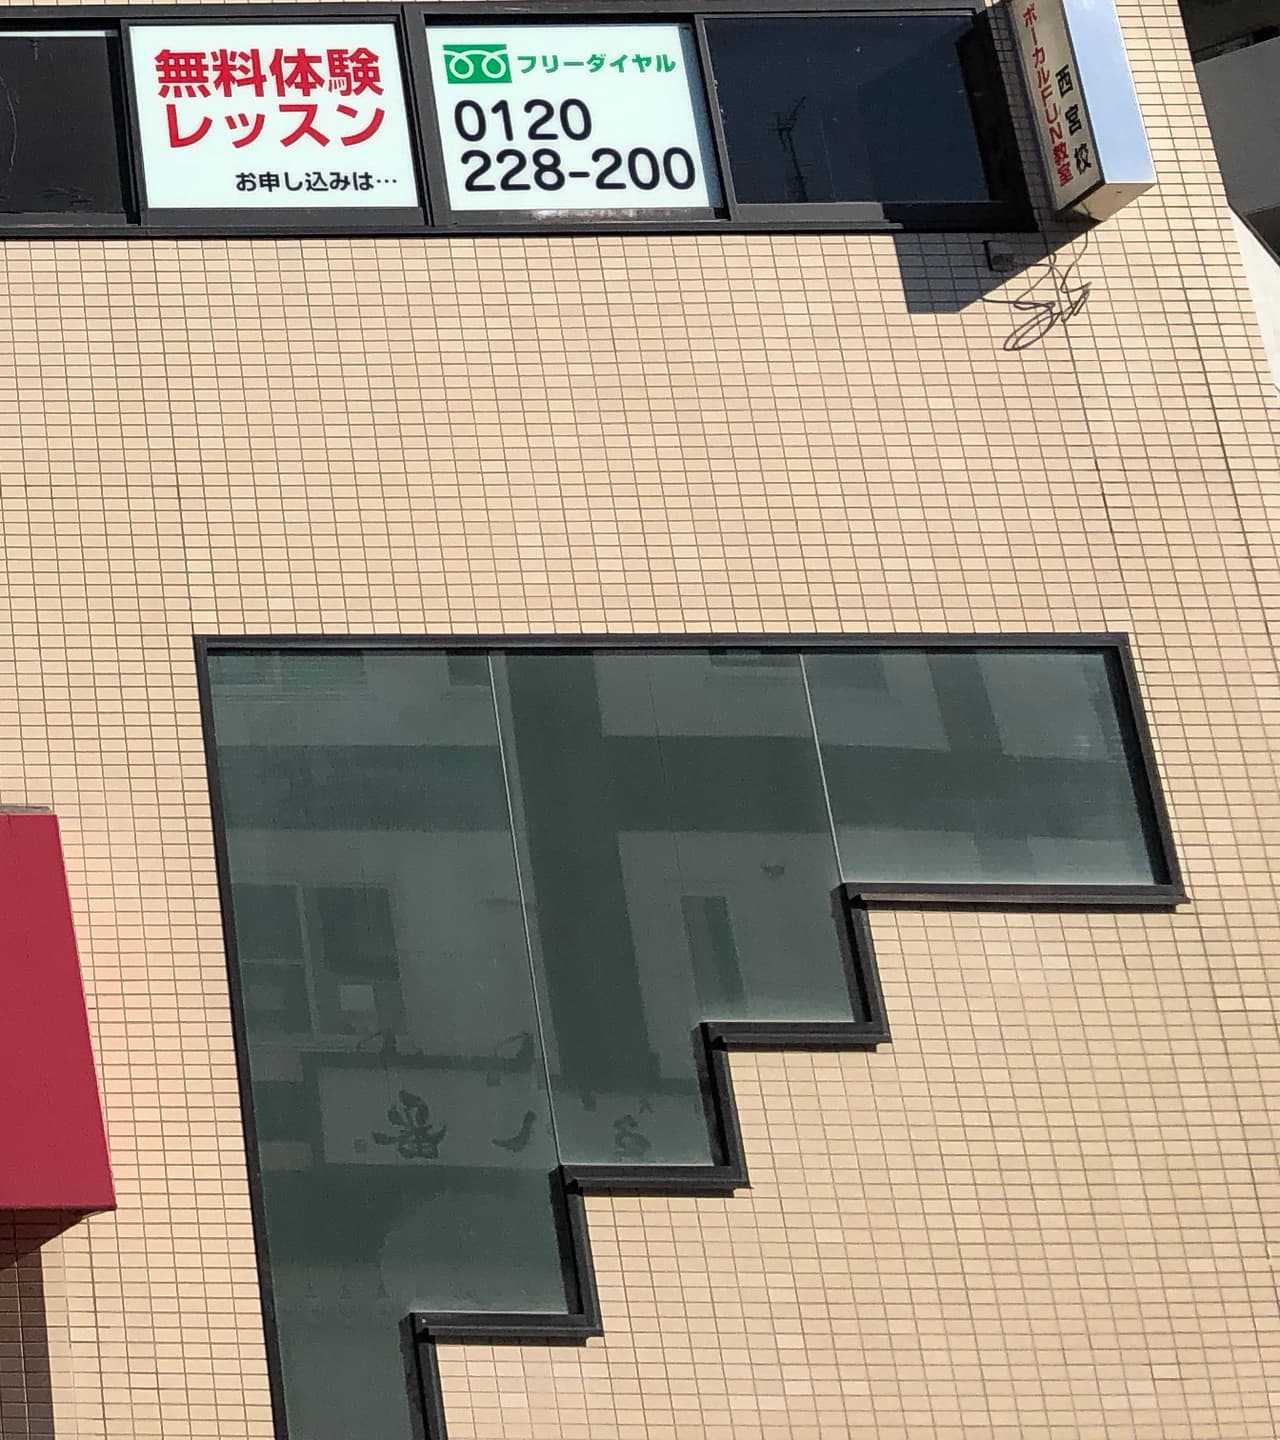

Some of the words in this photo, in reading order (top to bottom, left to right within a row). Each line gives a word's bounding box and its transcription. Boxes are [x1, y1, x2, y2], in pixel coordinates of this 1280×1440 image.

[154, 47, 385, 98] 無料体験
[516, 53, 676, 75] フリーダイヤル
[1022, 3, 1074, 188] ボーカルFUN教室
[165, 103, 386, 149] レッスン
[453, 97, 593, 142] 0120
[1055, 64, 1092, 176] 西宮校
[460, 146, 696, 192] 228-200
